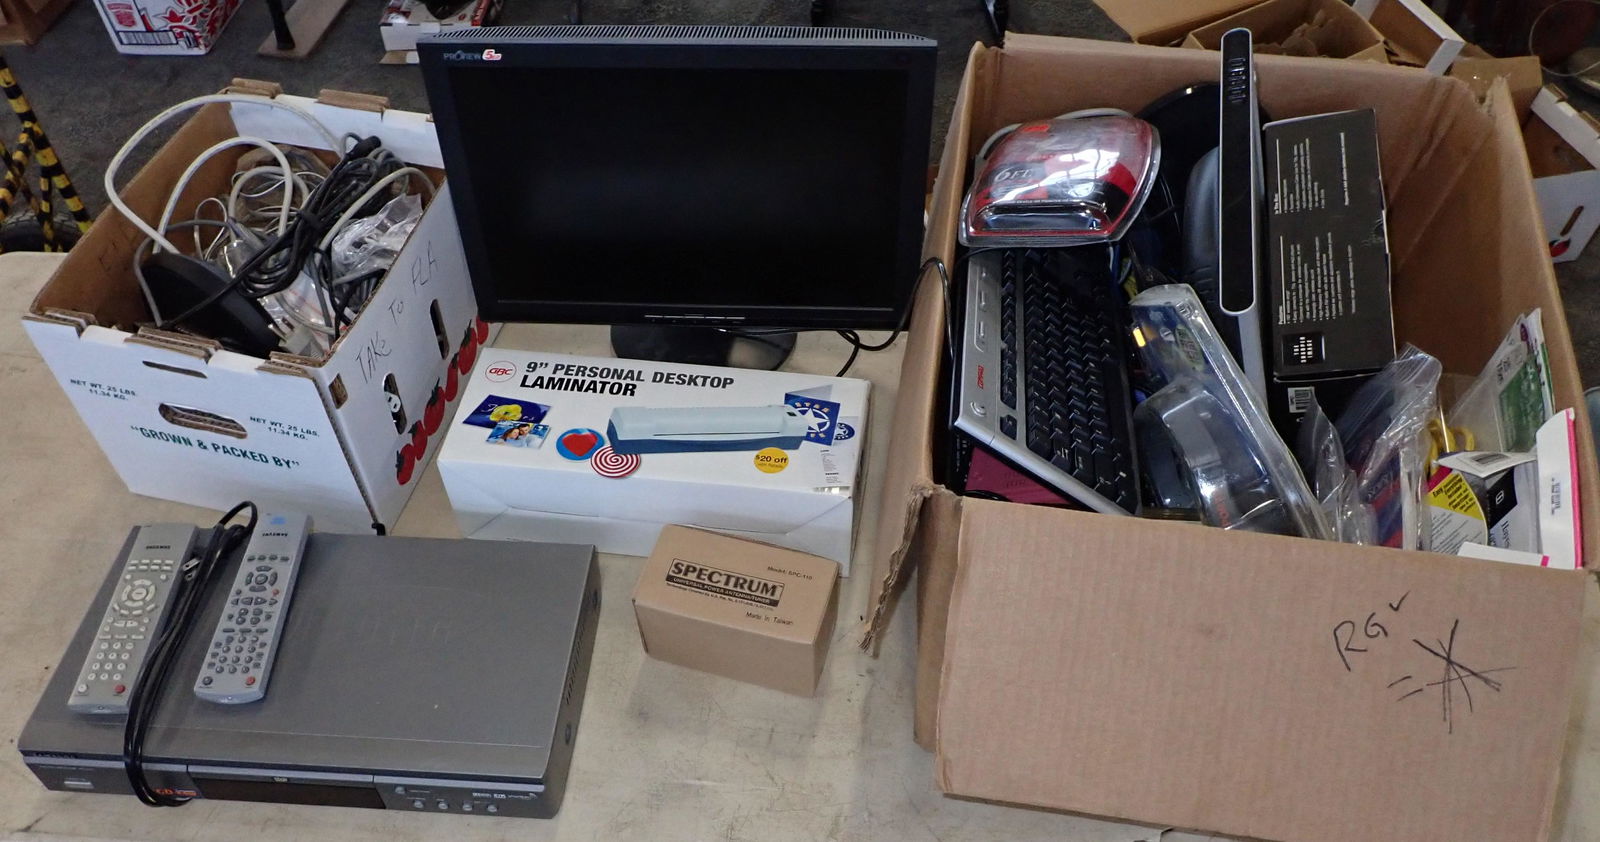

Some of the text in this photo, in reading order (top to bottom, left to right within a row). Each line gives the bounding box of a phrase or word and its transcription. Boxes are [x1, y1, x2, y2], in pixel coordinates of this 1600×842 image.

[355, 331, 392, 384] TAKE
[70, 378, 86, 387] NET
[520, 374, 637, 397] LAMINATOR
[552, 363, 645, 382] PERSONAL
[651, 371, 735, 389] DESKTOP
[249, 416, 266, 425] NET
[287, 424, 298, 432] 25
[267, 426, 290, 436] 11.34
[197, 439, 208, 450] &
[211, 442, 269, 464] PACKED
[671, 561, 777, 598] SPECTRUM
[704, 585, 725, 594] POWER
[773, 616, 794, 626] Taiwan
